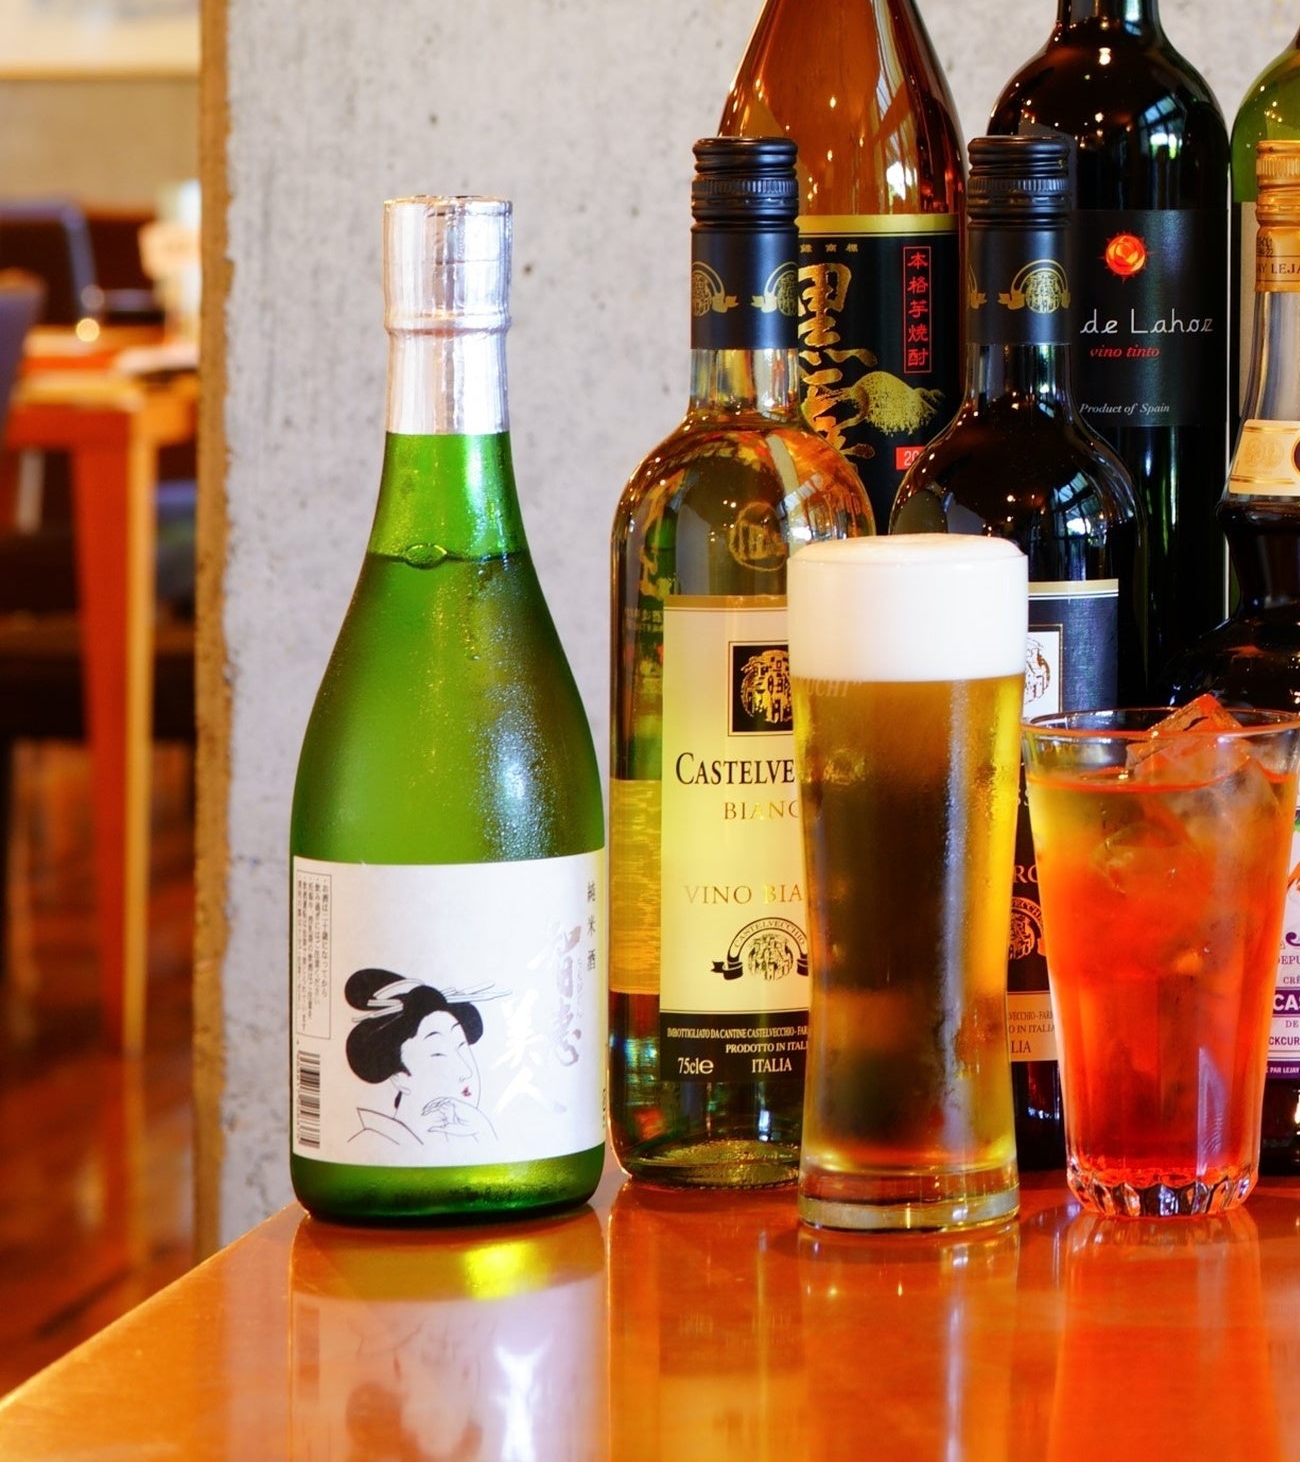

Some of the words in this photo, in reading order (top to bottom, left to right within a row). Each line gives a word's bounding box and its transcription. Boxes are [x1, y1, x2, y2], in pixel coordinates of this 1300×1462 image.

[906, 251, 930, 368] 本格芋焼酎
[1089, 346, 1123, 359] vino
[1125, 344, 1160, 359] tinto
[1079, 402, 1122, 415] Product
[1122, 402, 1138, 416] of
[1139, 402, 1170, 416] Spain
[675, 751, 796, 786] CASTELVE
[685, 884, 752, 905] VINO
[1017, 1023, 1026, 1034] IN
[1285, 1019, 1299, 1029] DE
[720, 1028, 747, 1039] CANTINE
[725, 1043, 775, 1054] PRODOTTO
[776, 1042, 786, 1052] IN
[751, 1057, 793, 1074] ITALIA
